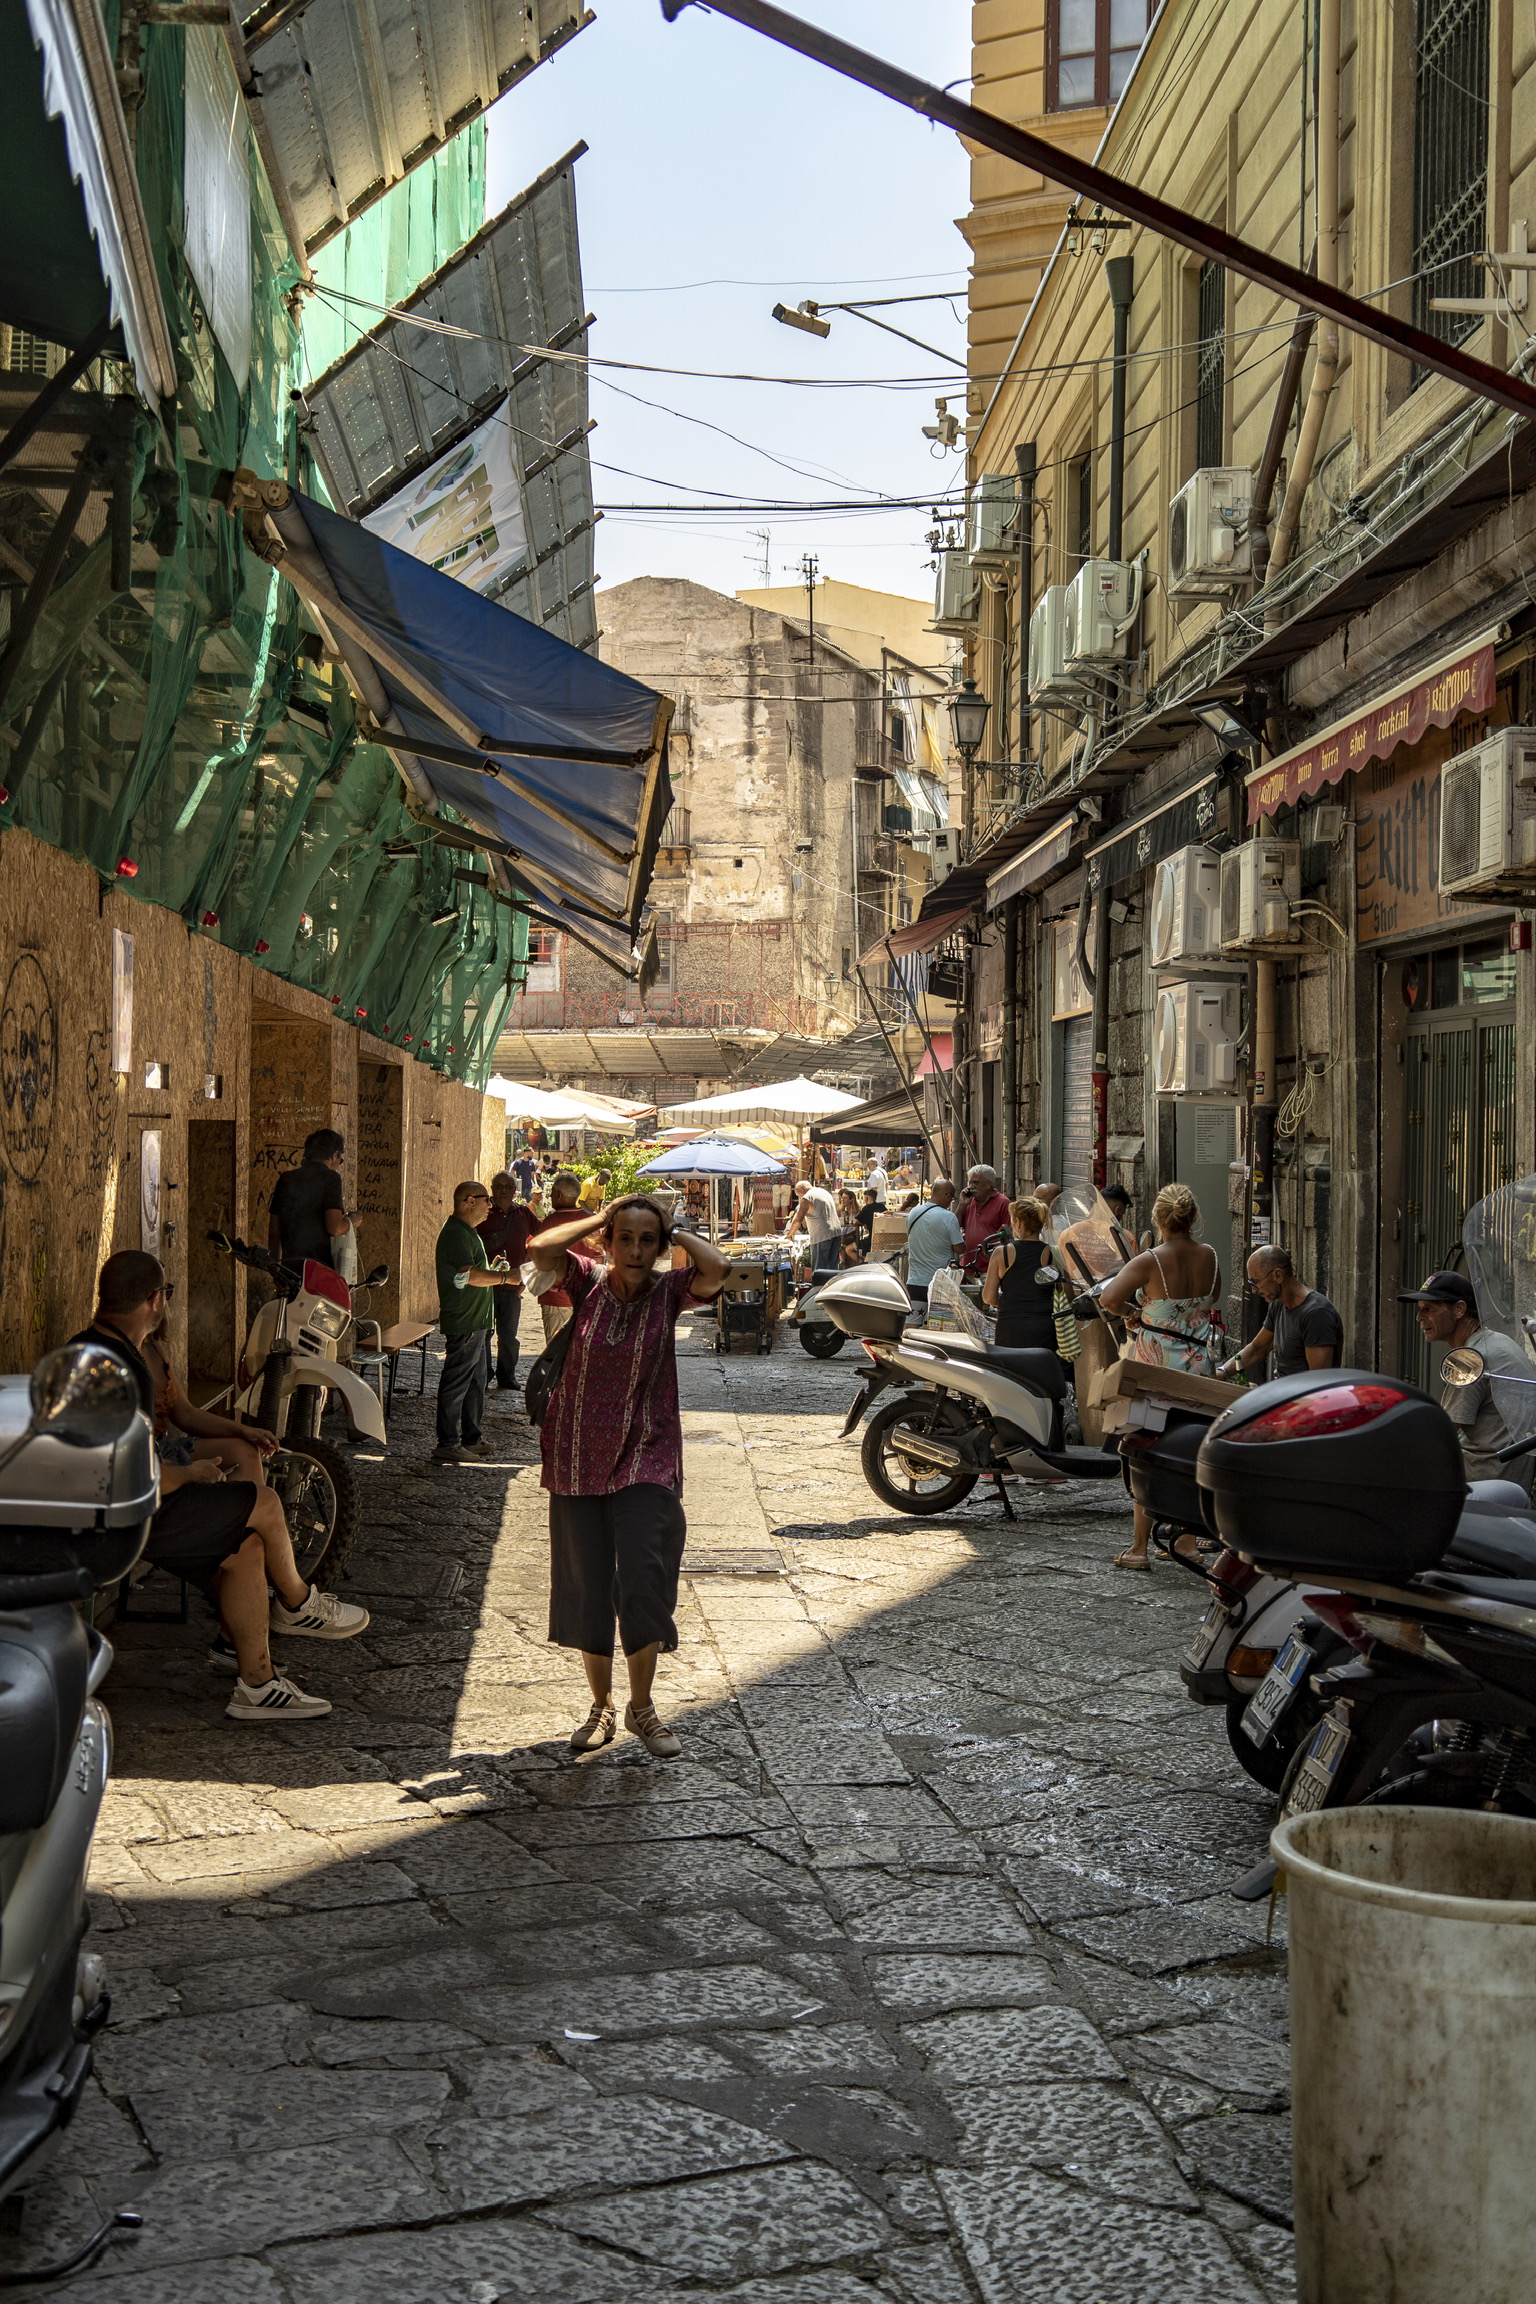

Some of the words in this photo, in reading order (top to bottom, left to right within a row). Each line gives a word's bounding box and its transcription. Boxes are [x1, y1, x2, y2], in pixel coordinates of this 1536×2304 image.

[1321, 746, 1339, 772] birra
[1349, 728, 1367, 759] shot
[1377, 702, 1410, 742] cocktail
[1432, 667, 1470, 713] Ritrovo
[1317, 1726, 1338, 1764] DZ
